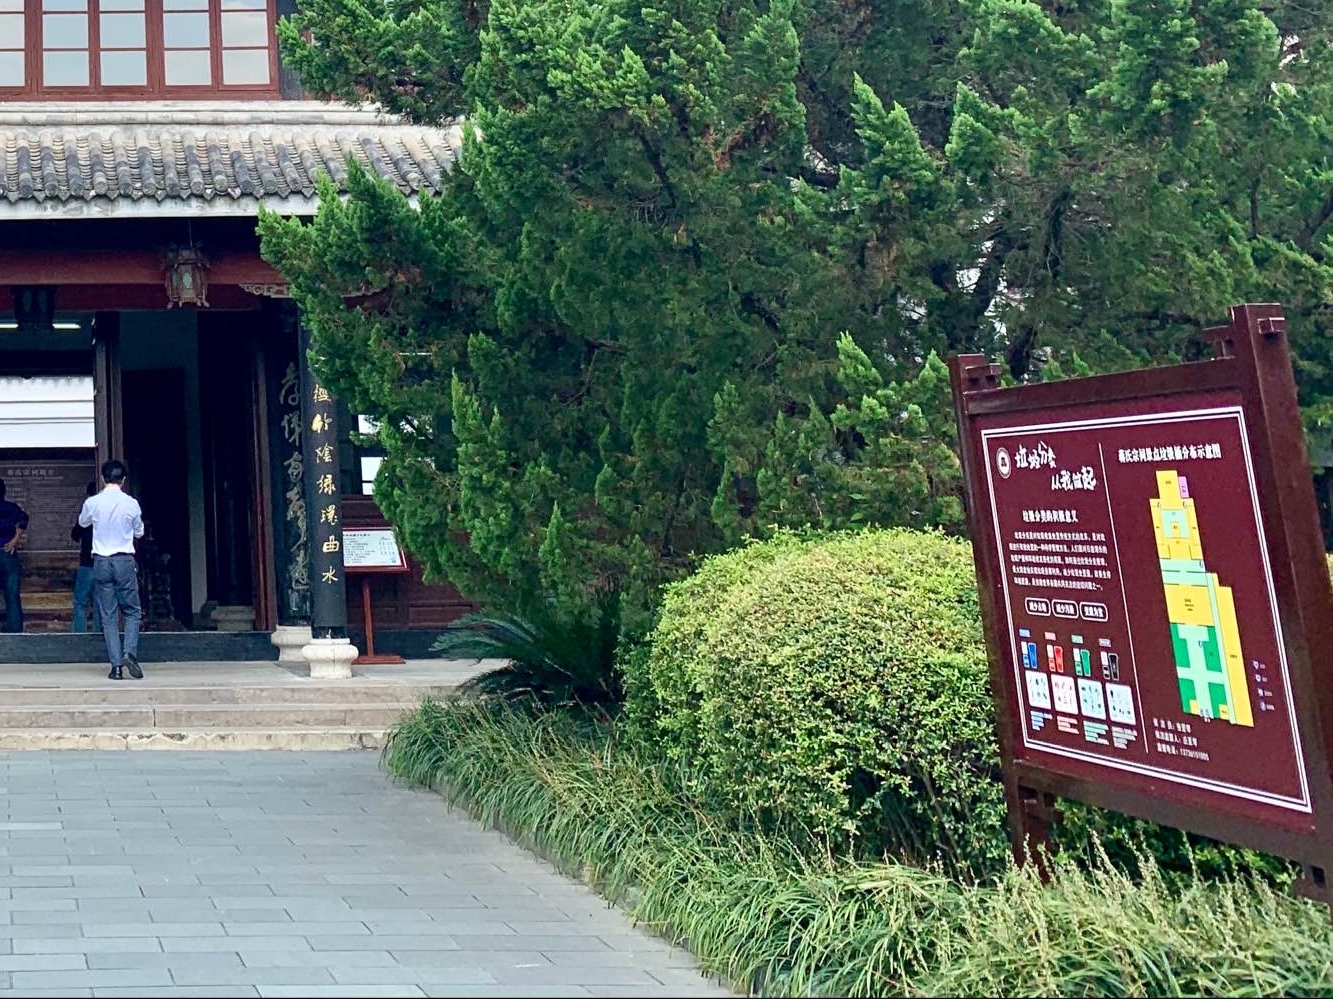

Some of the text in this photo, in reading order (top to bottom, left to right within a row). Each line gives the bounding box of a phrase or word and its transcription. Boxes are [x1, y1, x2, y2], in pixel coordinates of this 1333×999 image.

[1014, 440, 1057, 469] 垃圾分类
[1051, 465, 1097, 491] 从我做起
